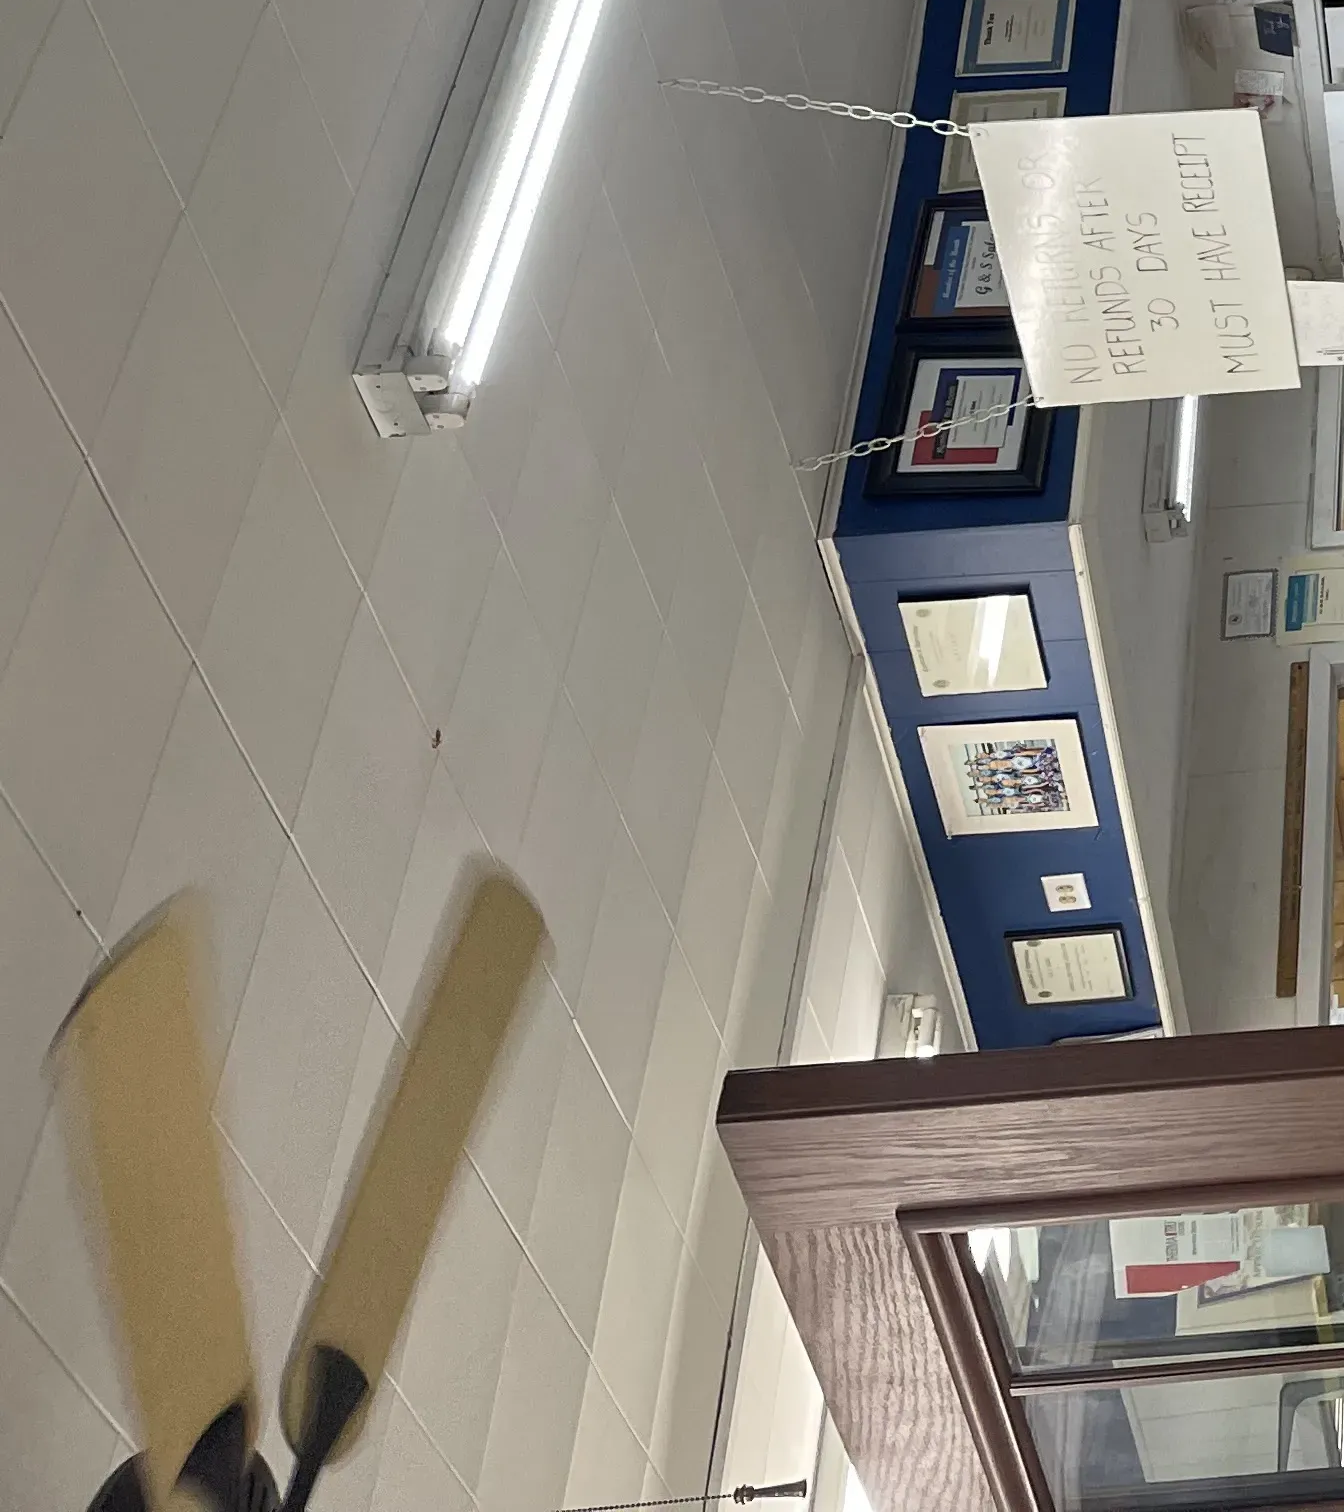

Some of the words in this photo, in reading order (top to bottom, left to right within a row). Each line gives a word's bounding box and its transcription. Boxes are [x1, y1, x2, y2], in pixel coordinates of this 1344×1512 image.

[1018, 152, 1055, 190] OR
[1172, 133, 1218, 212] RECEIPT
[1075, 177, 1116, 252] AFTER
[1126, 212, 1168, 272] DAYS
[1027, 213, 1090, 322] RETURNS
[1192, 224, 1240, 281] HAVE
[1090, 266, 1147, 375] REFUNDS
[1148, 298, 1179, 332] 30
[1210, 299, 1260, 374] MUST
[1060, 345, 1102, 384] NO
